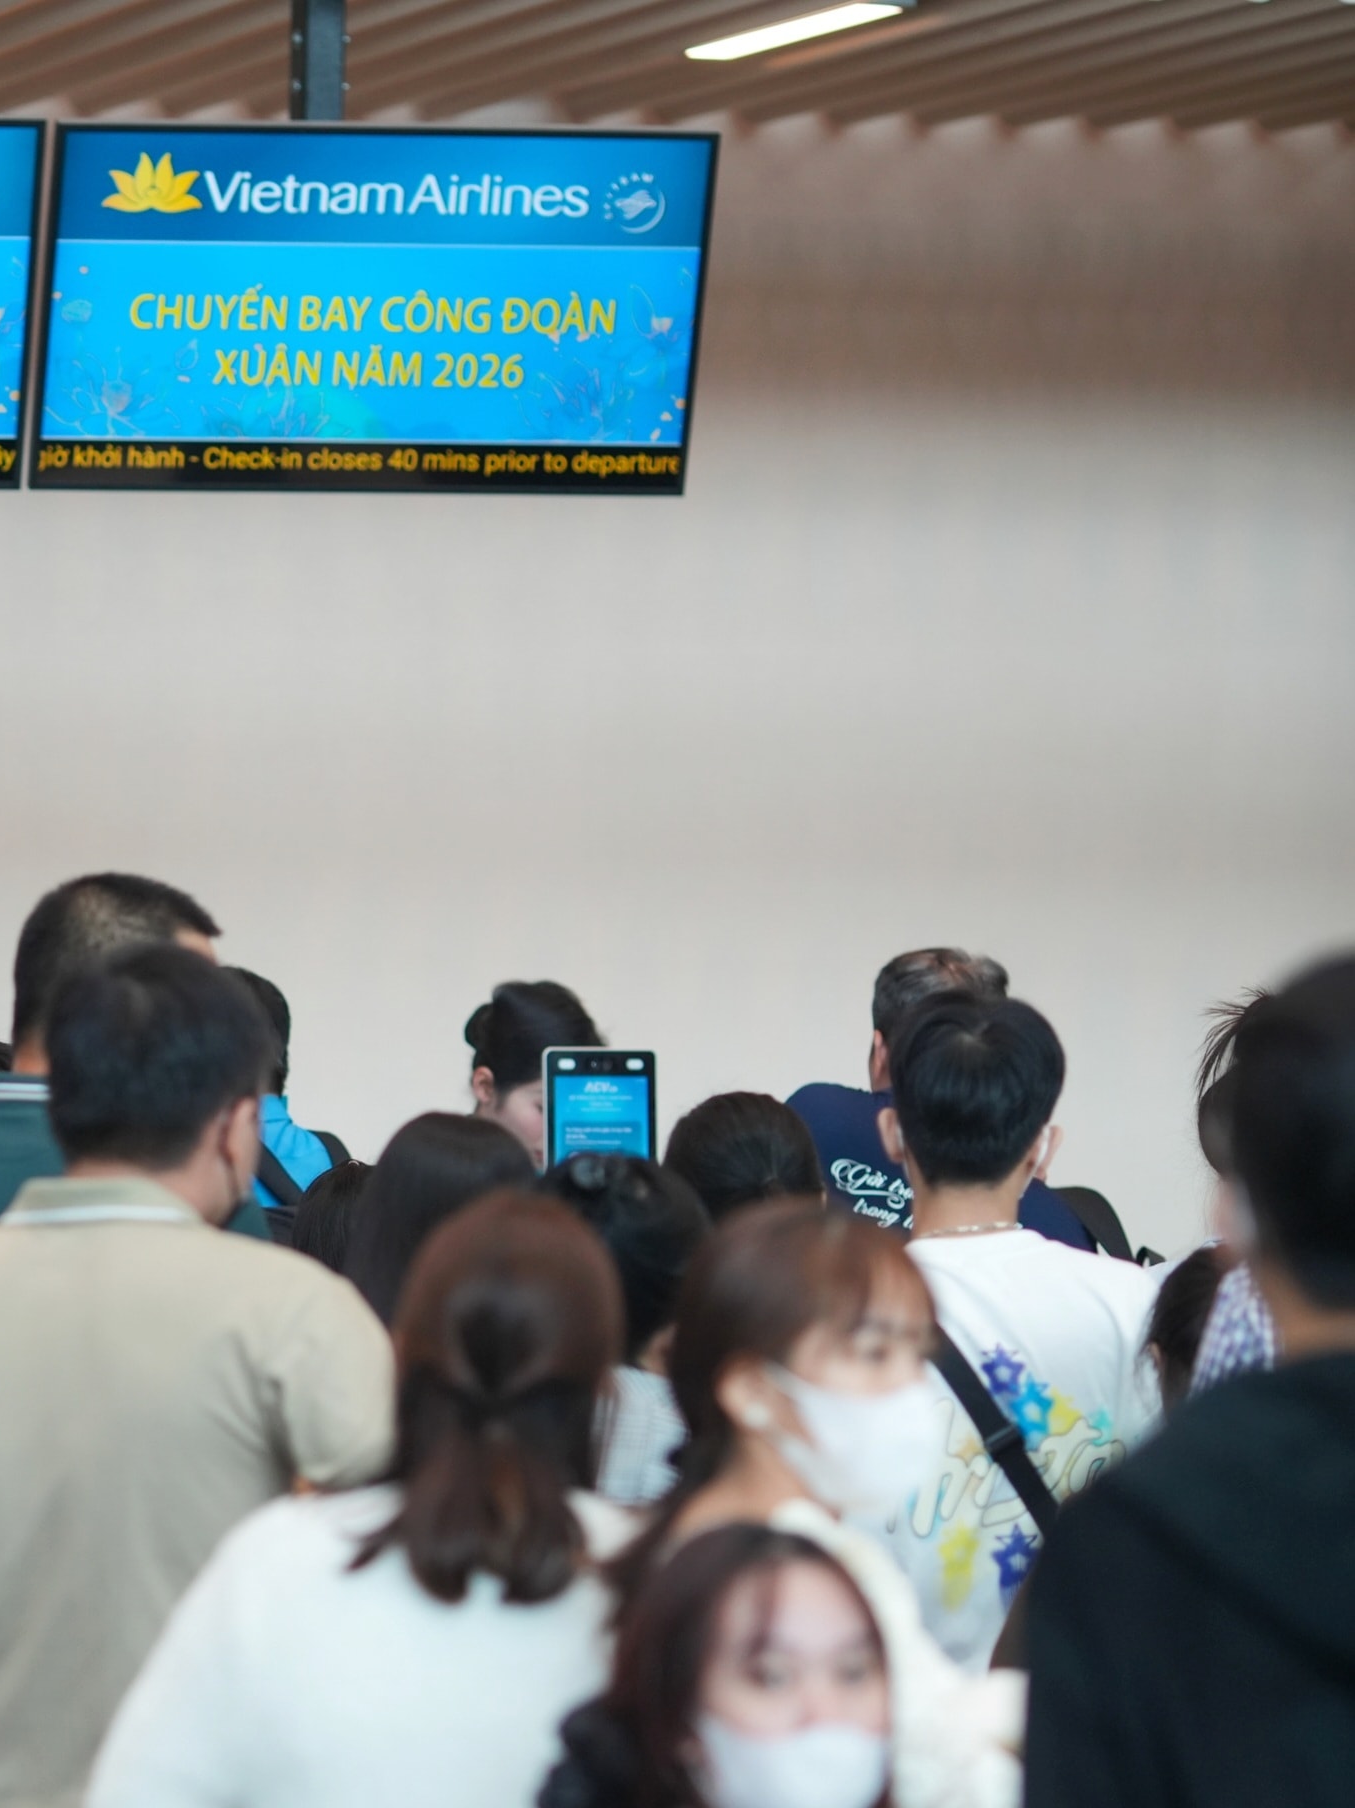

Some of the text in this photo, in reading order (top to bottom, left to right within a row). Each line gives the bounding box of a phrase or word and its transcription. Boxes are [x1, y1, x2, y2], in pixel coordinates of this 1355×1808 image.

[204, 171, 590, 218] Vietnam Airlines
[130, 283, 617, 334] CHUYẾN BAY CÔNG ĐOÀN
[212, 343, 524, 388] XUÂN NĂM 2026
[72, 444, 122, 469] khởi
[127, 444, 186, 469] hành
[203, 446, 302, 471] Check-in
[307, 447, 383, 471] closes
[387, 448, 418, 472] 40
[422, 449, 481, 473] mins
[484, 450, 539, 477] prior
[543, 453, 566, 474] to
